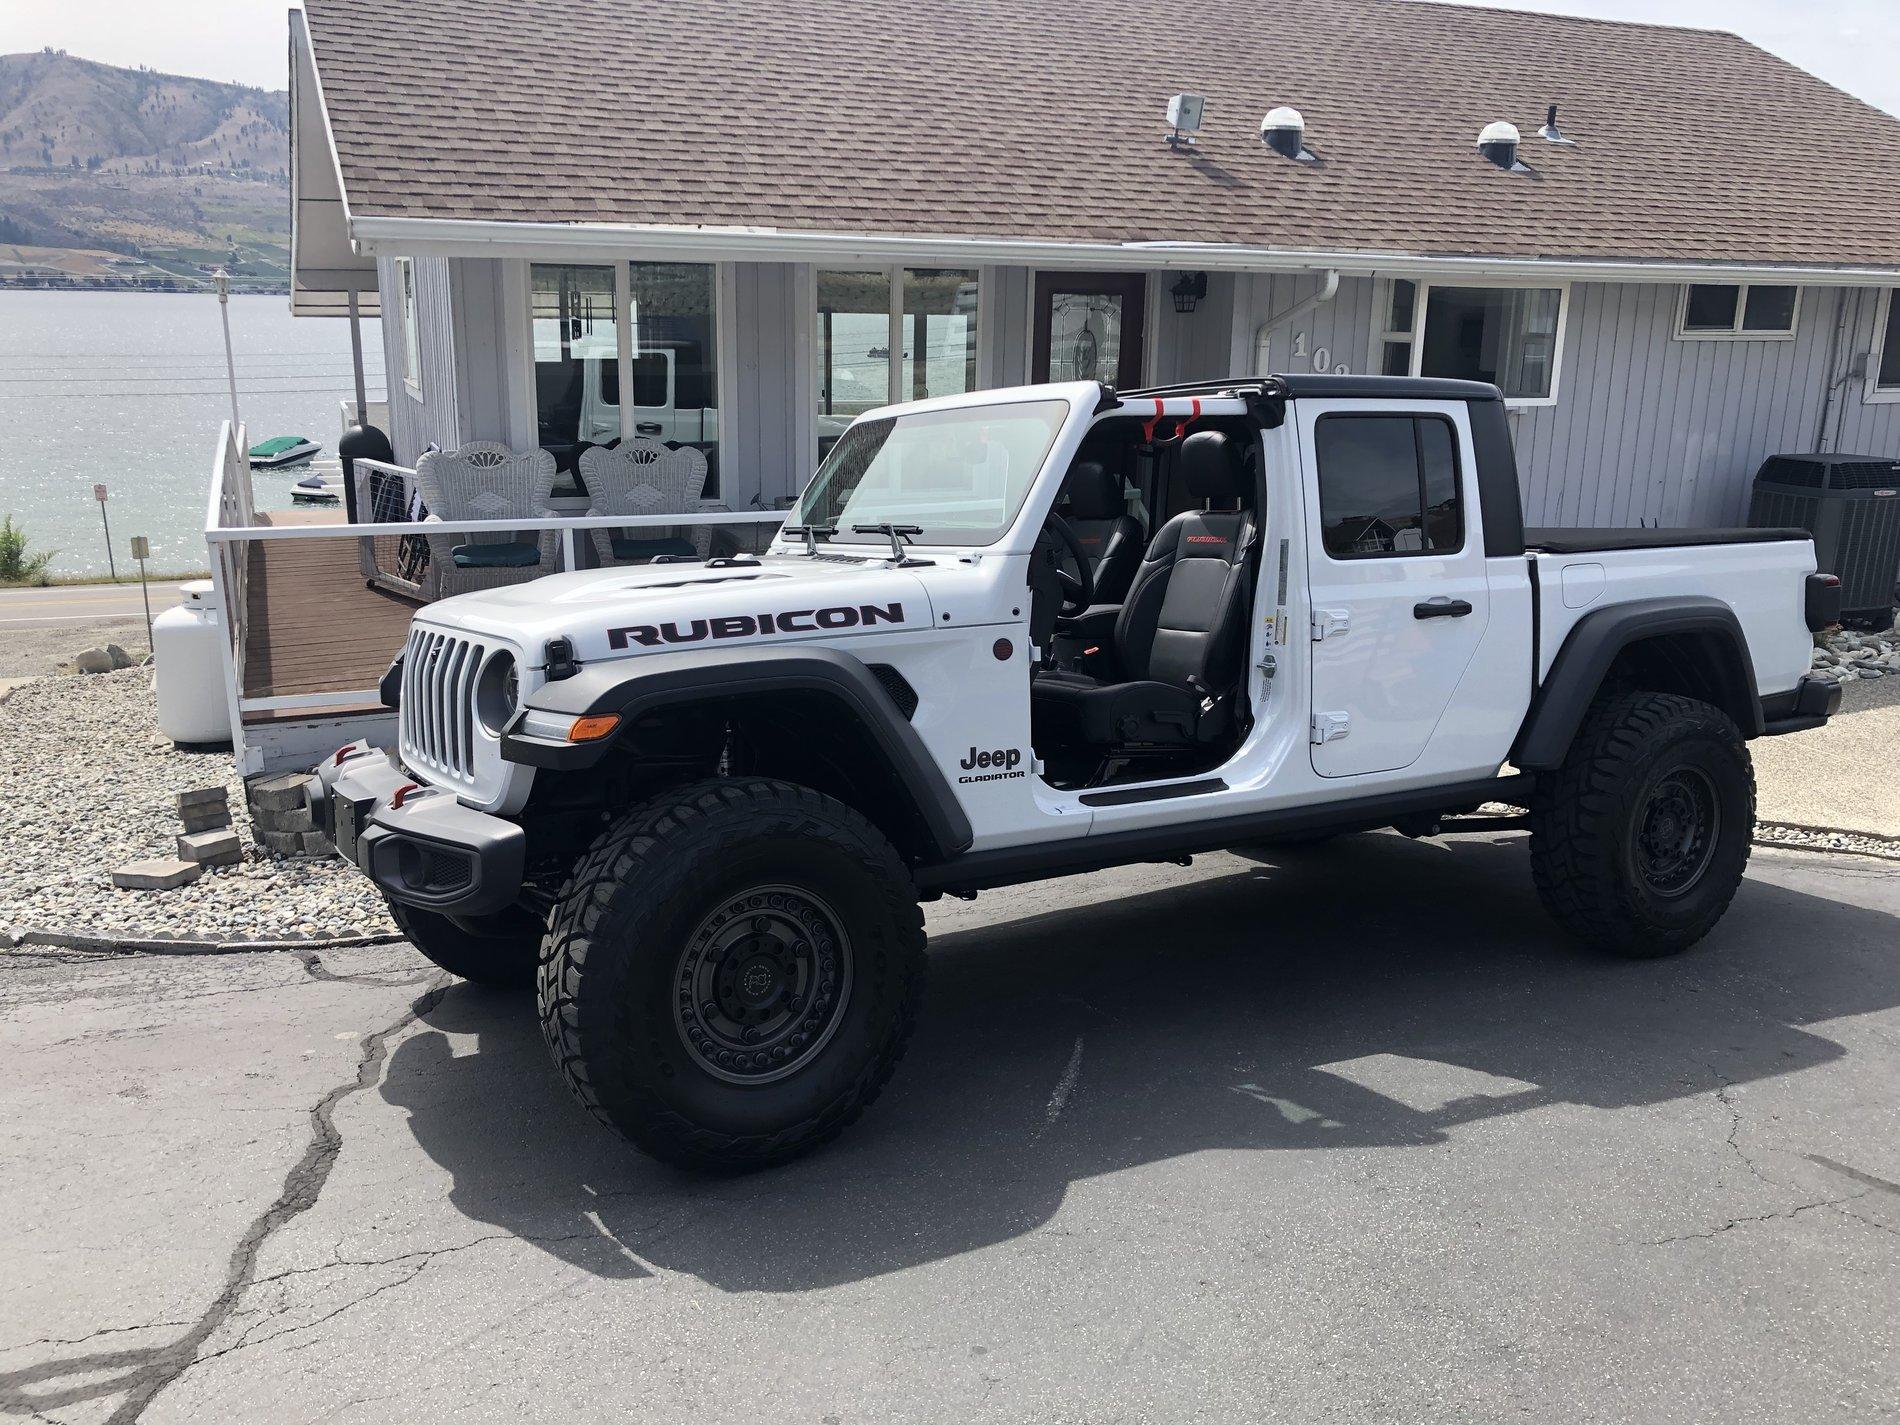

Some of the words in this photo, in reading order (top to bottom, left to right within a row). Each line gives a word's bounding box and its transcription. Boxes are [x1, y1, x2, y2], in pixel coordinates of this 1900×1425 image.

[607, 603, 905, 650] RUBICON
[960, 747, 1021, 770] Jeep
[958, 770, 1025, 784] GLADIATOR
